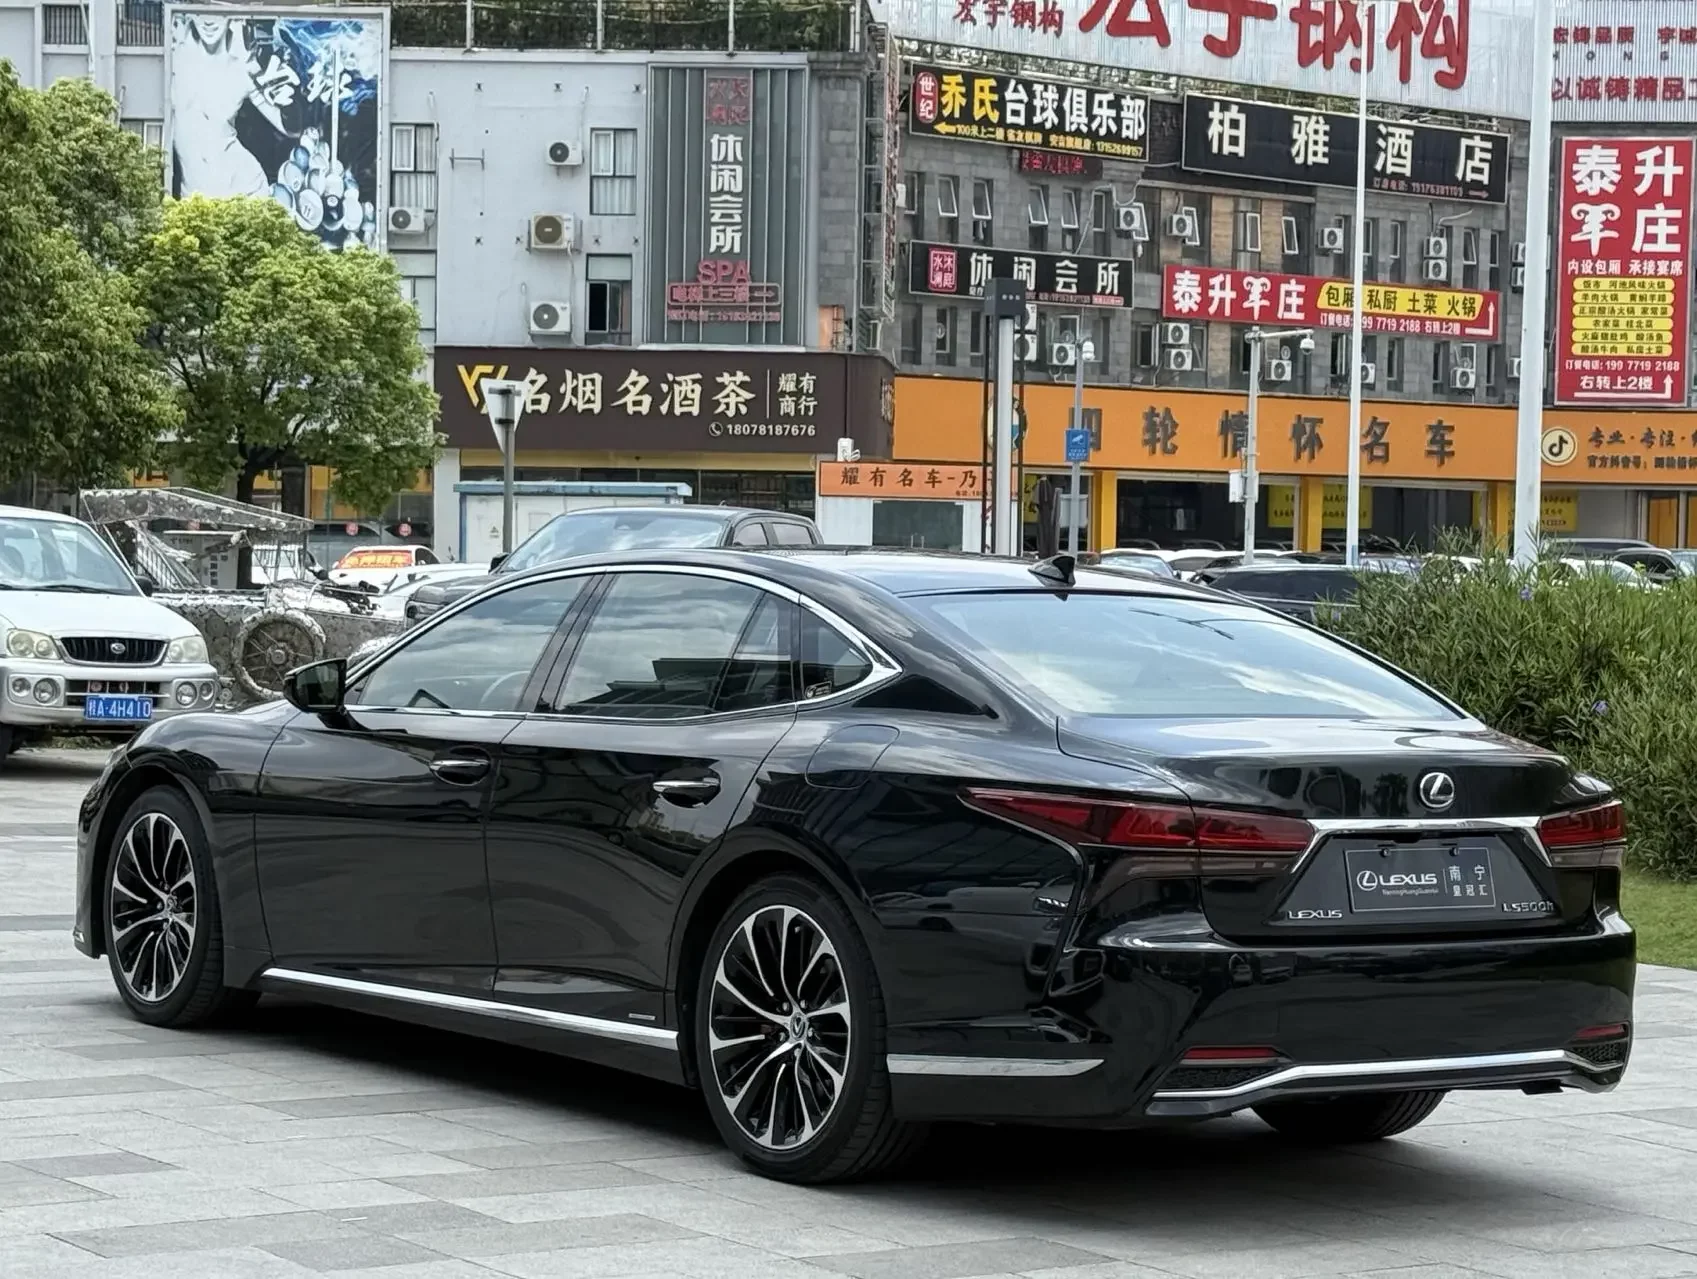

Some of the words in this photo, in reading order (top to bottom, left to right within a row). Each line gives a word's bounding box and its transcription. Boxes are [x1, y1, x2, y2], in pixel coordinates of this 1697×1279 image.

[256, 55, 353, 107] 台球
[919, 76, 935, 120] 世纪
[1208, 101, 1493, 186] 柏雅酒店
[1572, 144, 1684, 197] 泰升
[709, 134, 744, 254] 休闲会所
[698, 260, 751, 284] SPA
[969, 252, 1120, 295] 休闲会所
[1567, 259, 1621, 275] 内设包厢
[1629, 259, 1683, 276] 承接宴席
[1172, 270, 1306, 321] 泰升羊庄
[1367, 289, 1398, 312] 私厨
[1407, 292, 1437, 316] 土菜
[1447, 295, 1476, 317] 火锅
[1376, 316, 1397, 331] 7719
[1399, 318, 1421, 333] 2188
[1627, 360, 1651, 371] 7719
[1655, 361, 1680, 372] 2188
[524, 367, 756, 418] 名烟名酒茶
[777, 372, 817, 394] 耀有
[1580, 375, 1653, 390] 右转上2楼
[778, 394, 818, 417] 商行
[727, 424, 816, 437] 18078187676
[840, 466, 992, 488] 耀有名车-乃
[1379, 872, 1438, 886] LEXUS
[1449, 865, 1486, 881] 南宁
[1452, 884, 1489, 897] 皇冠汇
[1288, 909, 1343, 919] LEXUS
[1501, 901, 1554, 913] LS500h
